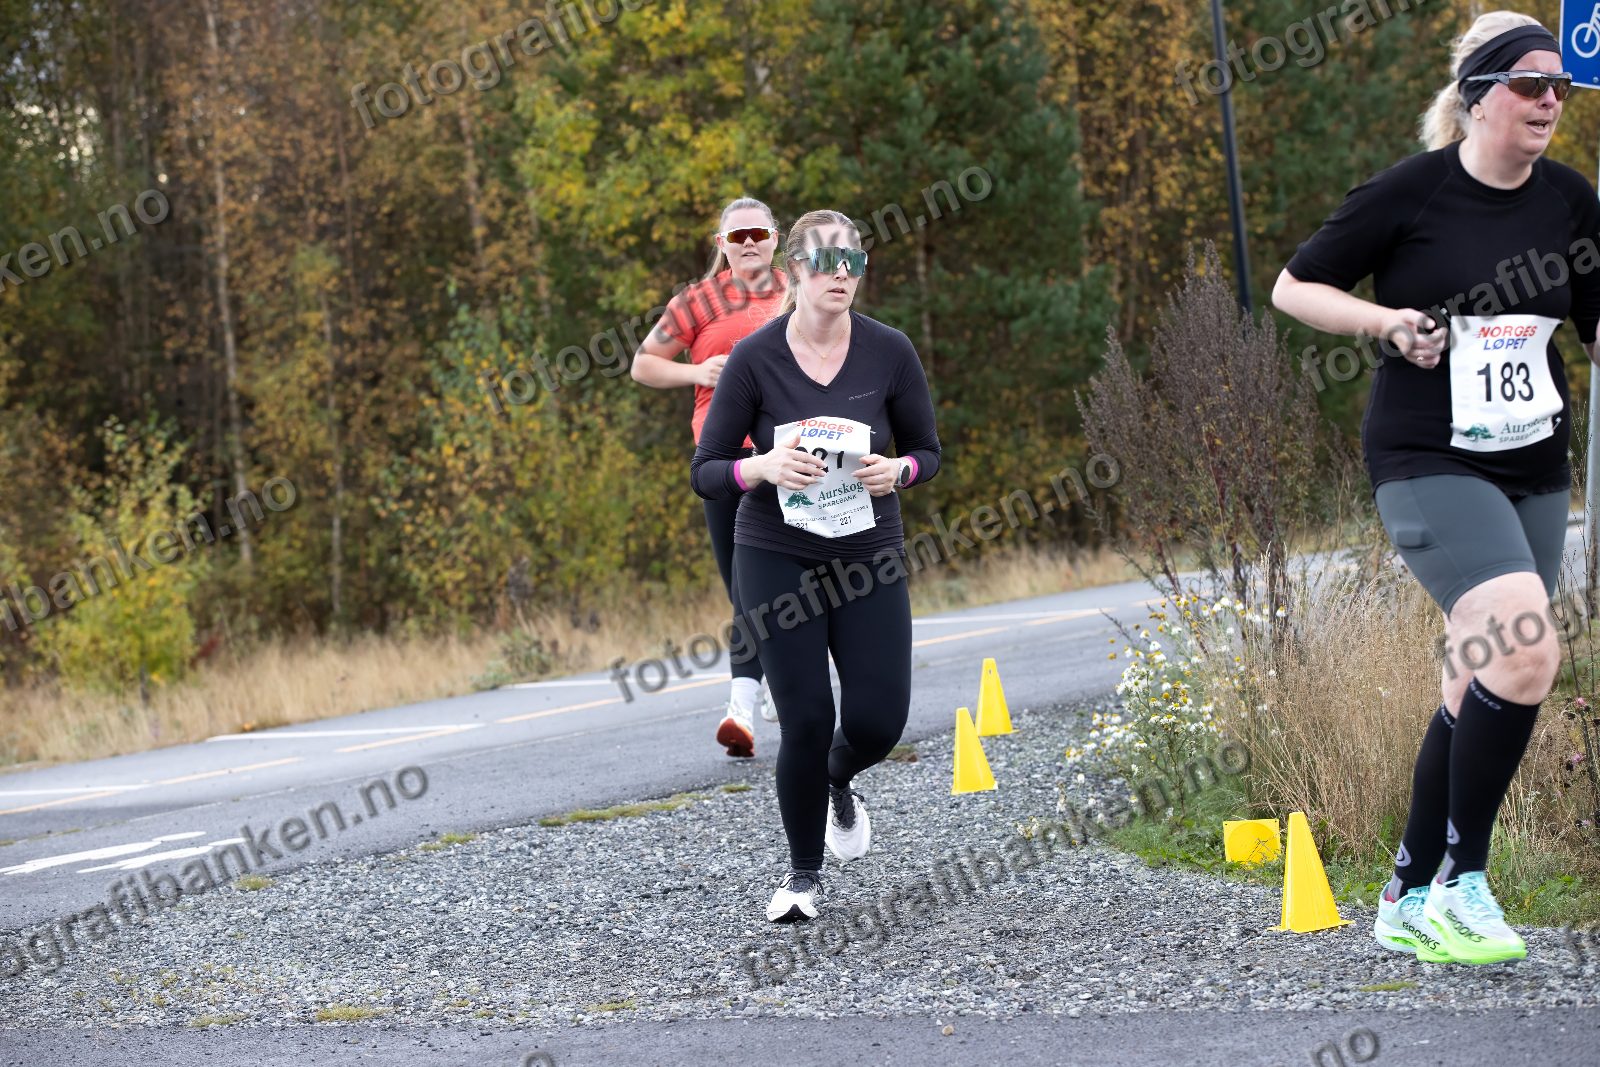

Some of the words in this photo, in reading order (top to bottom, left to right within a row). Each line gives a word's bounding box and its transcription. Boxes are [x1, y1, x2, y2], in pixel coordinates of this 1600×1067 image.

[1475, 326, 1538, 338] NORGES
[1483, 338, 1527, 350] LØPET
[1477, 361, 1534, 402] 183
[798, 419, 854, 433] NORGES
[801, 428, 844, 440] LØPET
[818, 480, 864, 502] Aurskog
[839, 515, 852, 526] 221
[1401, 921, 1441, 951] BROOKS
